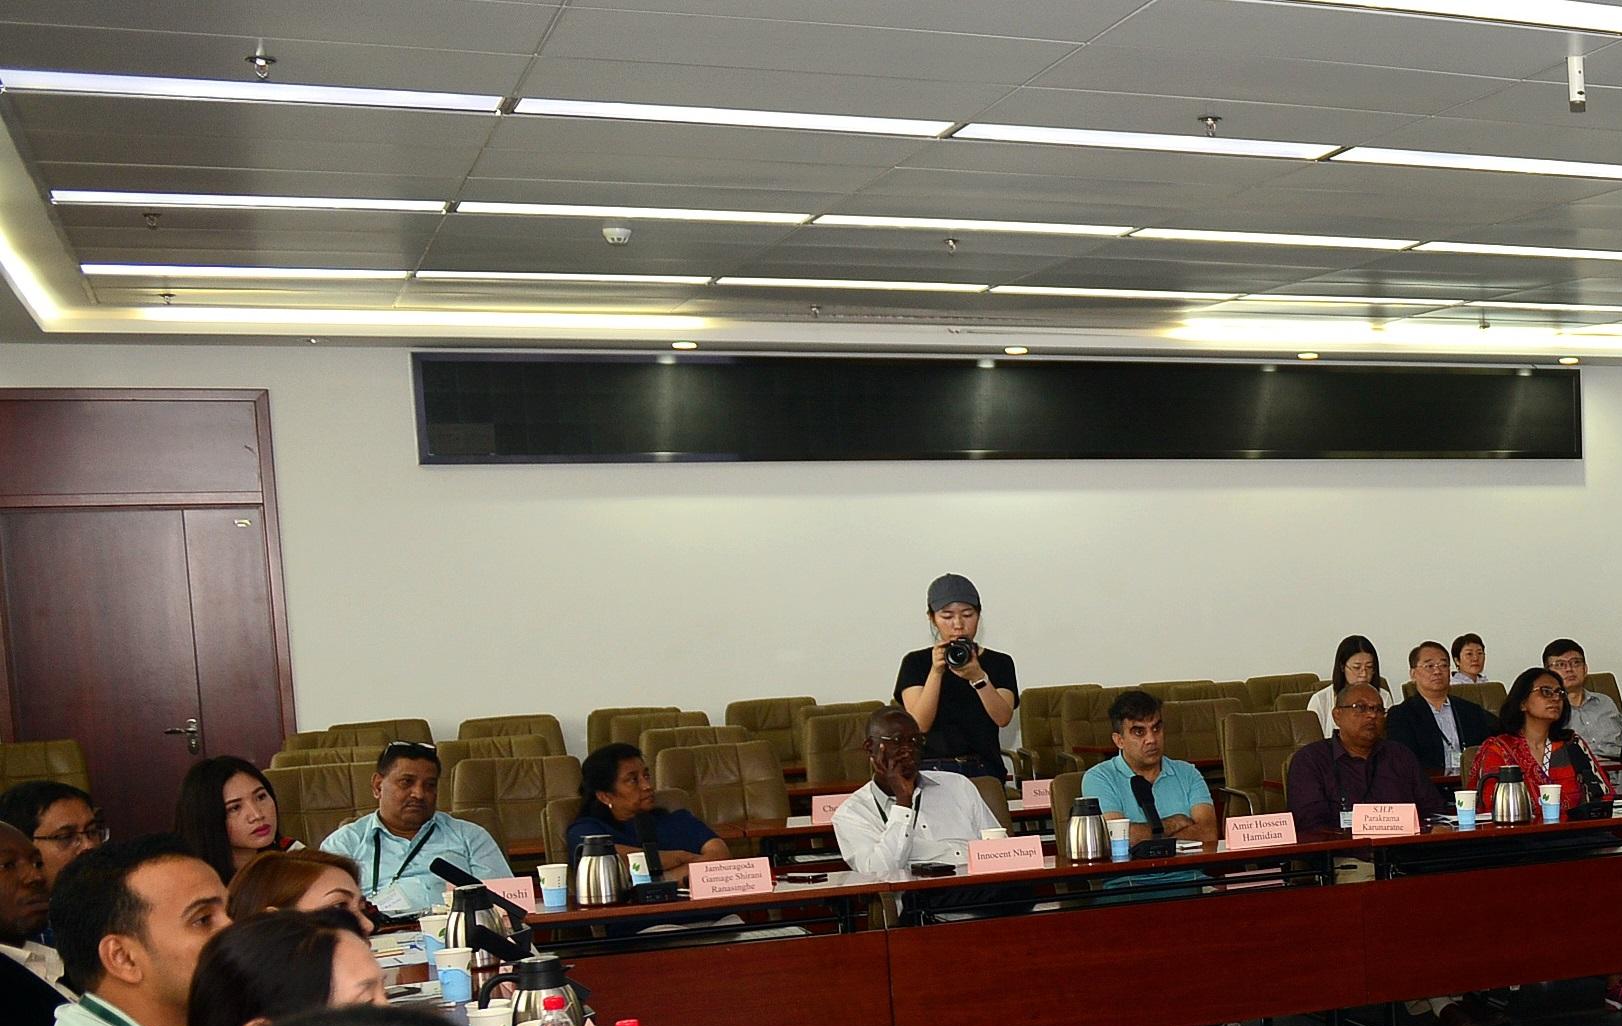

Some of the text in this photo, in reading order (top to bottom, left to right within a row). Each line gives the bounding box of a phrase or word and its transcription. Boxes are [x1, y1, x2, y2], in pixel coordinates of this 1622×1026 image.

[1364, 814, 1400, 822] Parakrama
[1232, 819, 1288, 830] Amir Hossein
[1362, 823, 1404, 831] Karunaratne
[1242, 831, 1283, 841] Hamidian
[977, 848, 1037, 860] Innocent Nhapi
[702, 875, 733, 884] Gamage
[712, 883, 756, 893] Ranasinghe
[502, 889, 528, 899] Joshi
